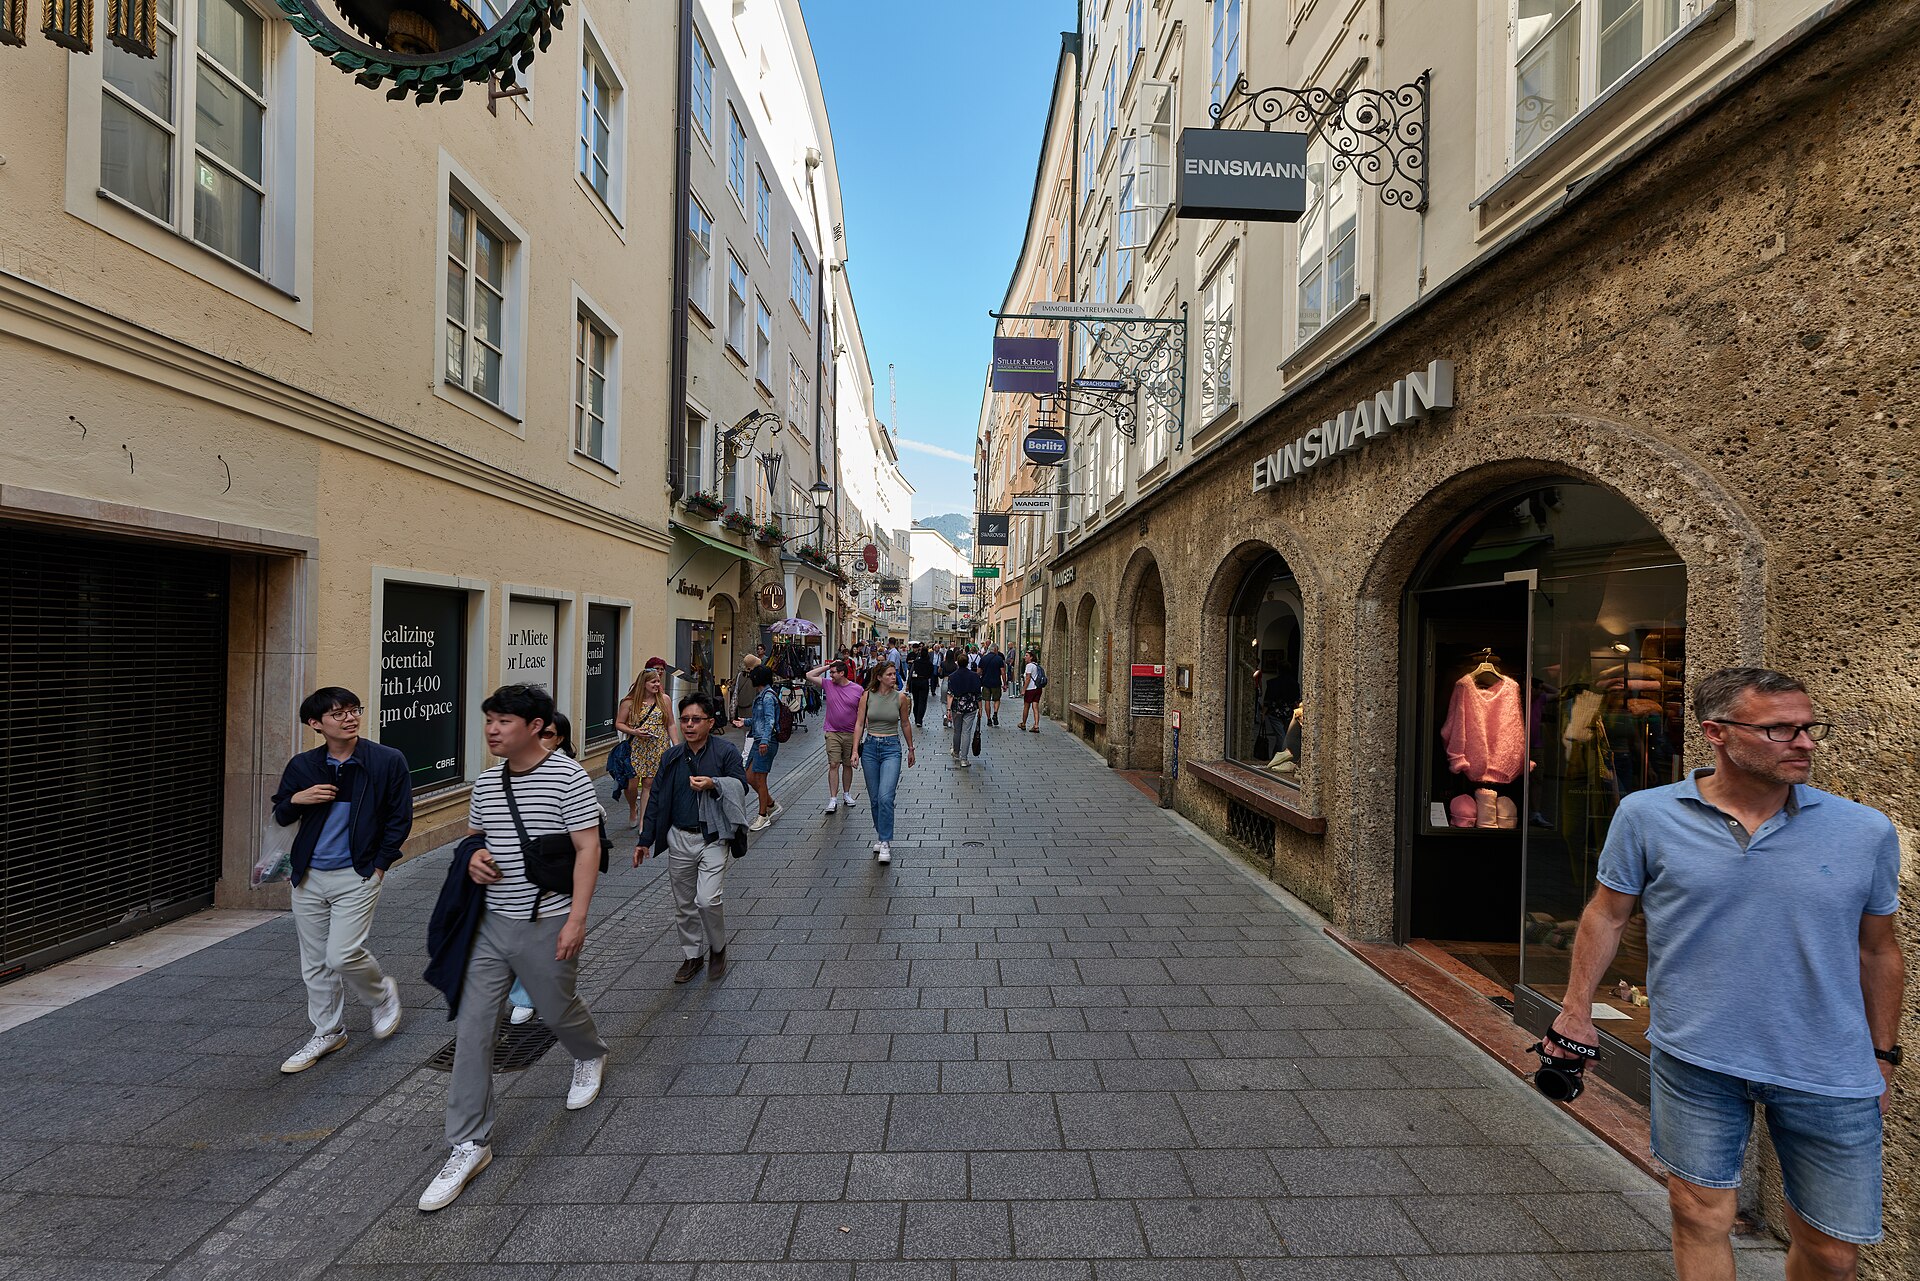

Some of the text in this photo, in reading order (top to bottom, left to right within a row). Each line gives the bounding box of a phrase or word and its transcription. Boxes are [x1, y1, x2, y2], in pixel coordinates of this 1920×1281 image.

[1185, 159, 1305, 179] ENNSMANN
[1042, 305, 1134, 314] IMMOBILIENTREUHÄNDER
[1022, 358, 1028, 366] &
[1080, 380, 1117, 388] SPRACHSCHULE
[1253, 359, 1454, 493] ENNSMANN
[1028, 440, 1063, 451] Berlitz
[382, 624, 435, 648] ealizing
[508, 629, 548, 646] ur Miete
[381, 650, 432, 670] otential
[519, 652, 546, 669] Lease
[587, 647, 604, 659] ential
[406, 674, 441, 696] 1,400
[380, 700, 453, 728] qm of space
[435, 757, 455, 769] CBRE
[1557, 1038, 1596, 1057] SONY
